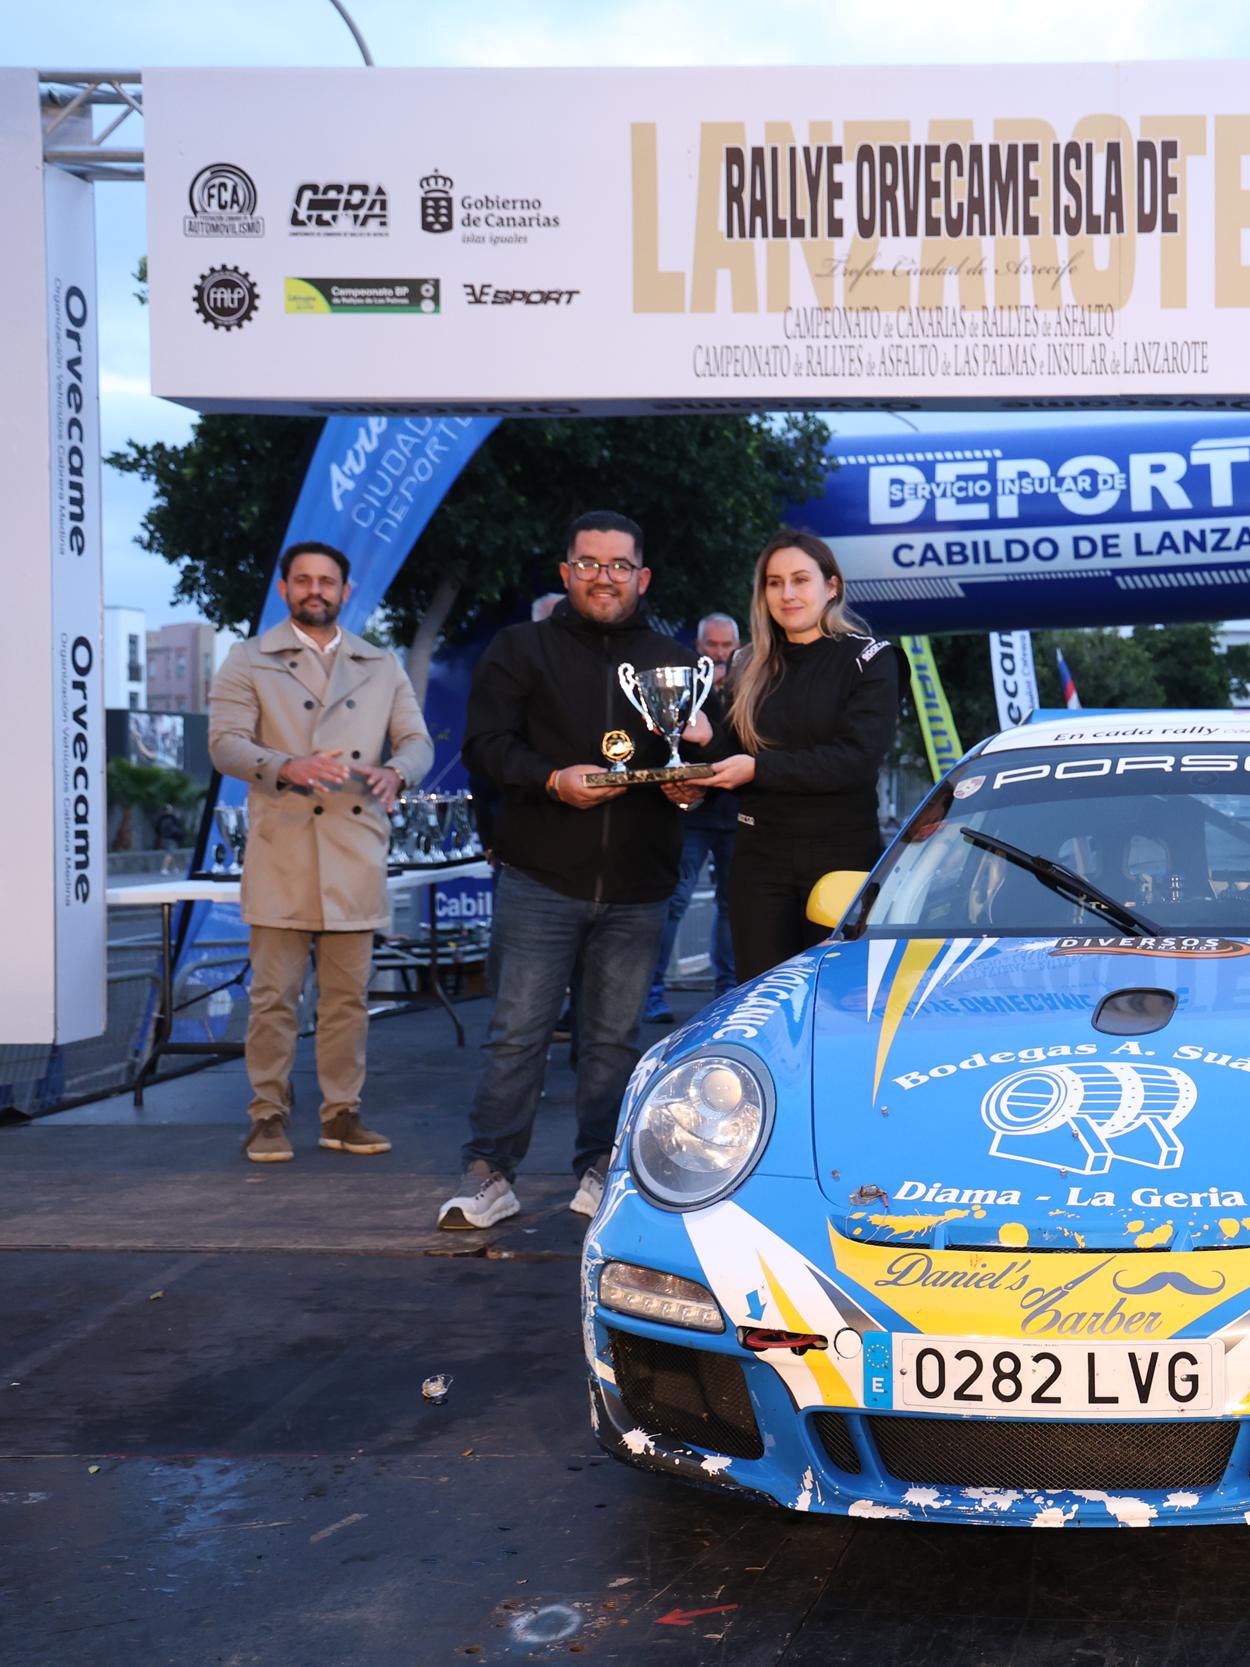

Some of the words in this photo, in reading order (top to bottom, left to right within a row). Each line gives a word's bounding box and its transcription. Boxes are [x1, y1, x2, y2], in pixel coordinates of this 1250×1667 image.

[207, 182, 240, 210] FCA
[461, 195, 542, 211] Gobierno
[725, 146, 844, 239] RALLYE
[856, 142, 1040, 239] ORVECAME
[1053, 141, 1124, 237] ISLA
[1136, 140, 1178, 234] DE
[188, 221, 261, 235] AUTOMOVILISMO
[461, 213, 481, 228] de
[484, 213, 560, 228] Canarias
[784, 306, 881, 339] CAMPEONATO
[896, 305, 967, 339] CANARIAS
[982, 305, 1039, 337] RALLYES
[1054, 303, 1115, 339] ASFALTO
[693, 344, 790, 378] CAMPEONATO
[806, 345, 863, 377] RALLYES
[878, 344, 939, 377] ASFALTO
[954, 344, 980, 376] LAS
[982, 343, 1037, 376] PALMAS
[1048, 343, 1109, 376] INSULAR
[1123, 341, 1209, 374] LANZAROTE
[65, 285, 88, 557] Orvecame
[889, 478, 992, 502] SERVICIO
[997, 473, 1092, 496] INSULAR
[1097, 472, 1127, 492] DE
[892, 536, 1059, 569] CABILDO
[1073, 532, 1122, 560] DE
[1053, 732, 1084, 741] En
[1092, 727, 1153, 738] cada
[1161, 725, 1221, 736] rally
[71, 636, 92, 904] Orvecame
[435, 892, 493, 917] Cabil
[1061, 937, 1220, 949] DIVERSOS
[892, 1041, 1098, 1091] Bodegas
[1110, 1040, 1156, 1056] A.
[893, 1180, 1021, 1206] Diama
[1066, 1187, 1115, 1207] La
[1131, 1187, 1248, 1208] Geria
[874, 1252, 1029, 1292] Daniel's
[1020, 1285, 1163, 1337] Barber
[872, 1377, 884, 1392] E
[915, 1347, 1063, 1404] 0282
[1088, 1351, 1200, 1404] LVG
